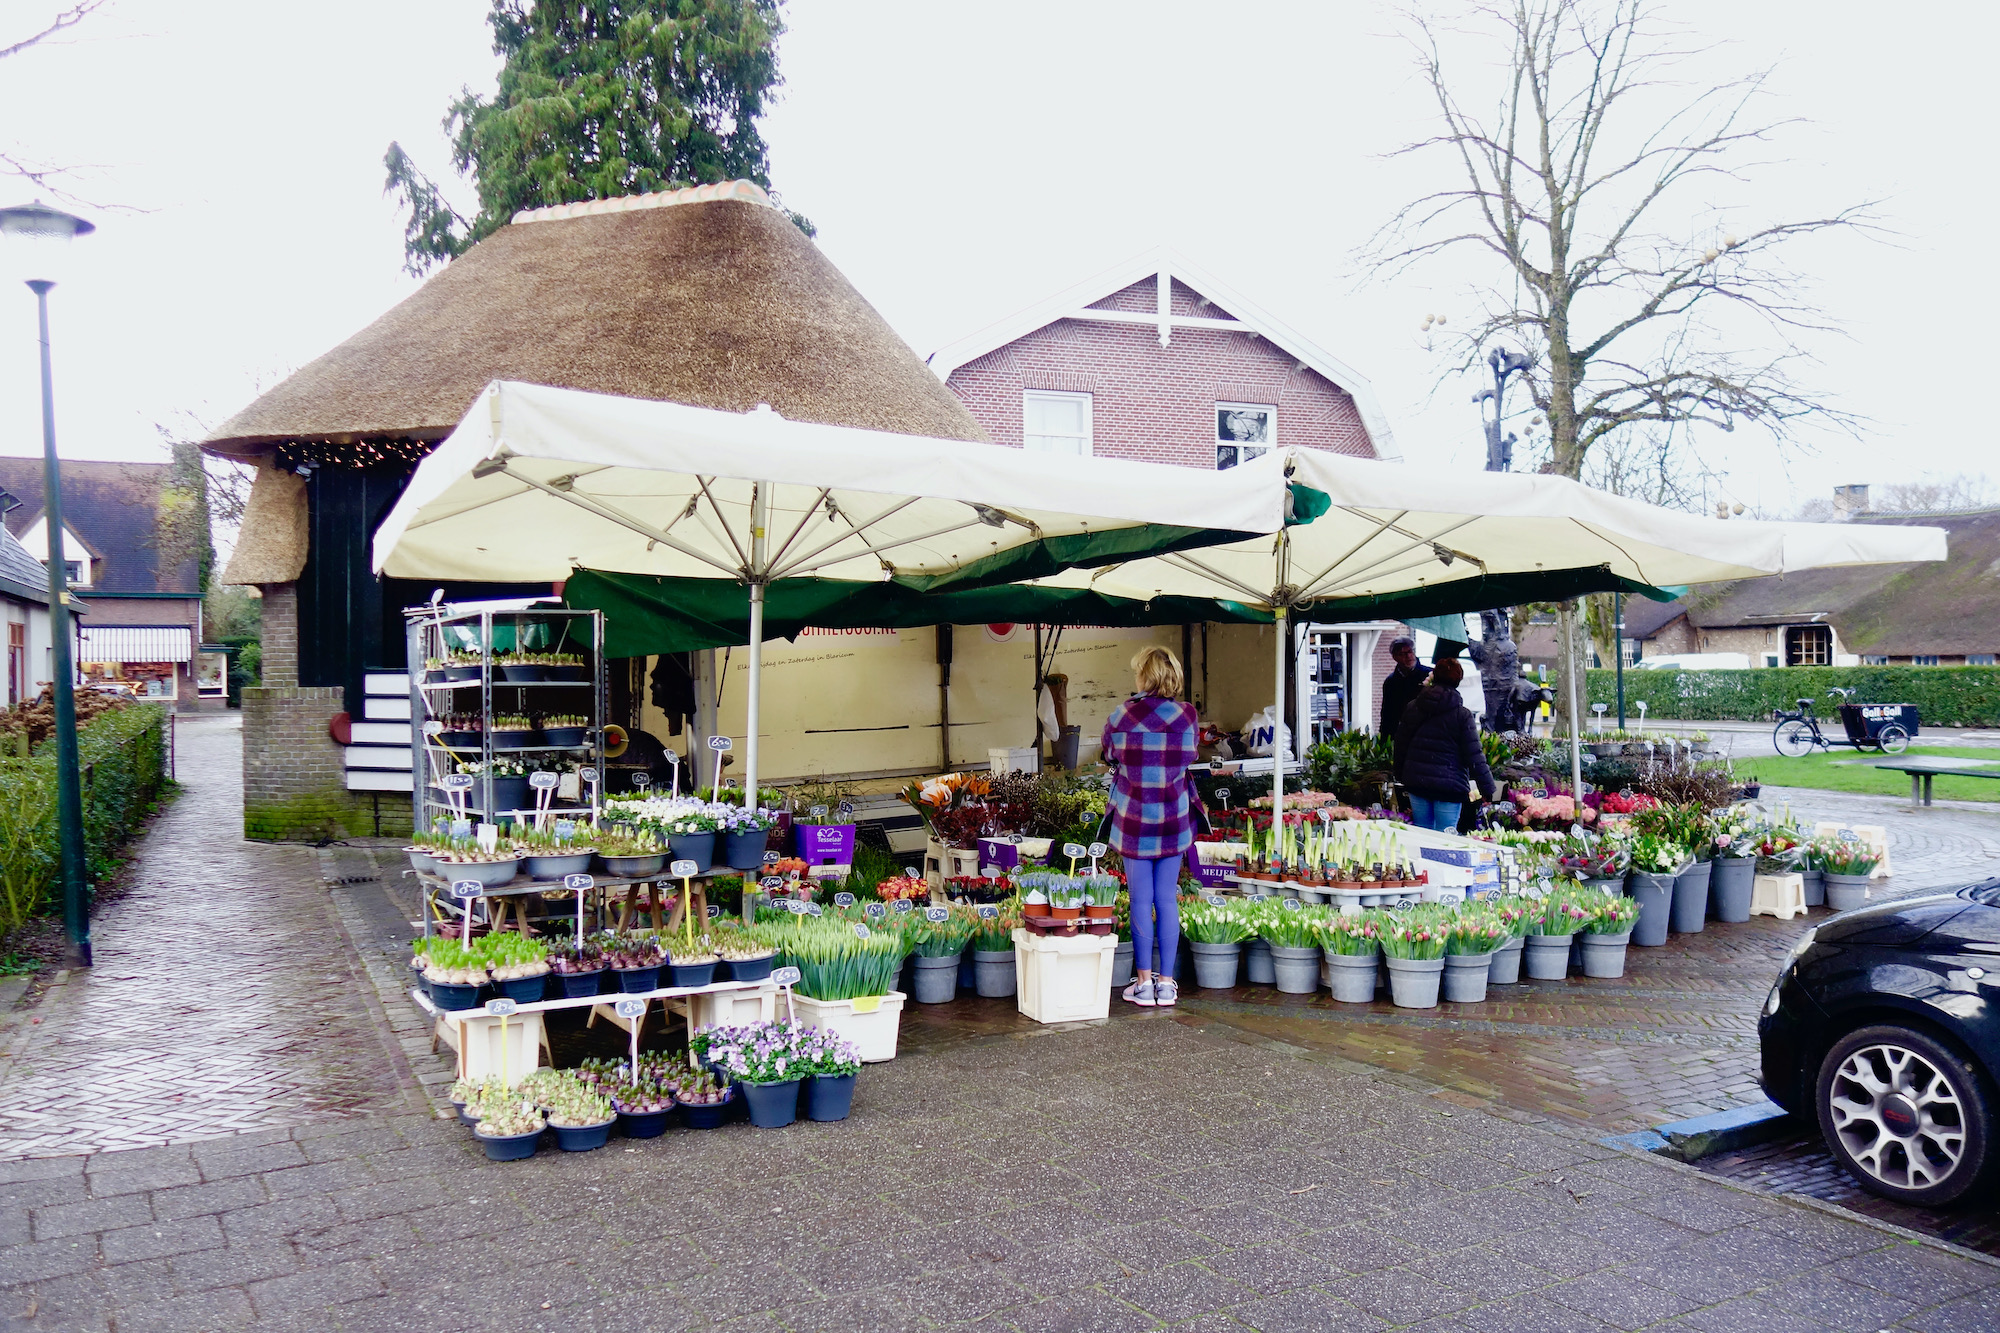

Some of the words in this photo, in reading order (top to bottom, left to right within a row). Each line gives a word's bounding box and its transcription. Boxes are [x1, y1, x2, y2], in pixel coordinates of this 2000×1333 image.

[788, 655, 815, 665] Zaterdag
[826, 651, 855, 660] Blaricum
[1202, 868, 1236, 877] MEIJER
